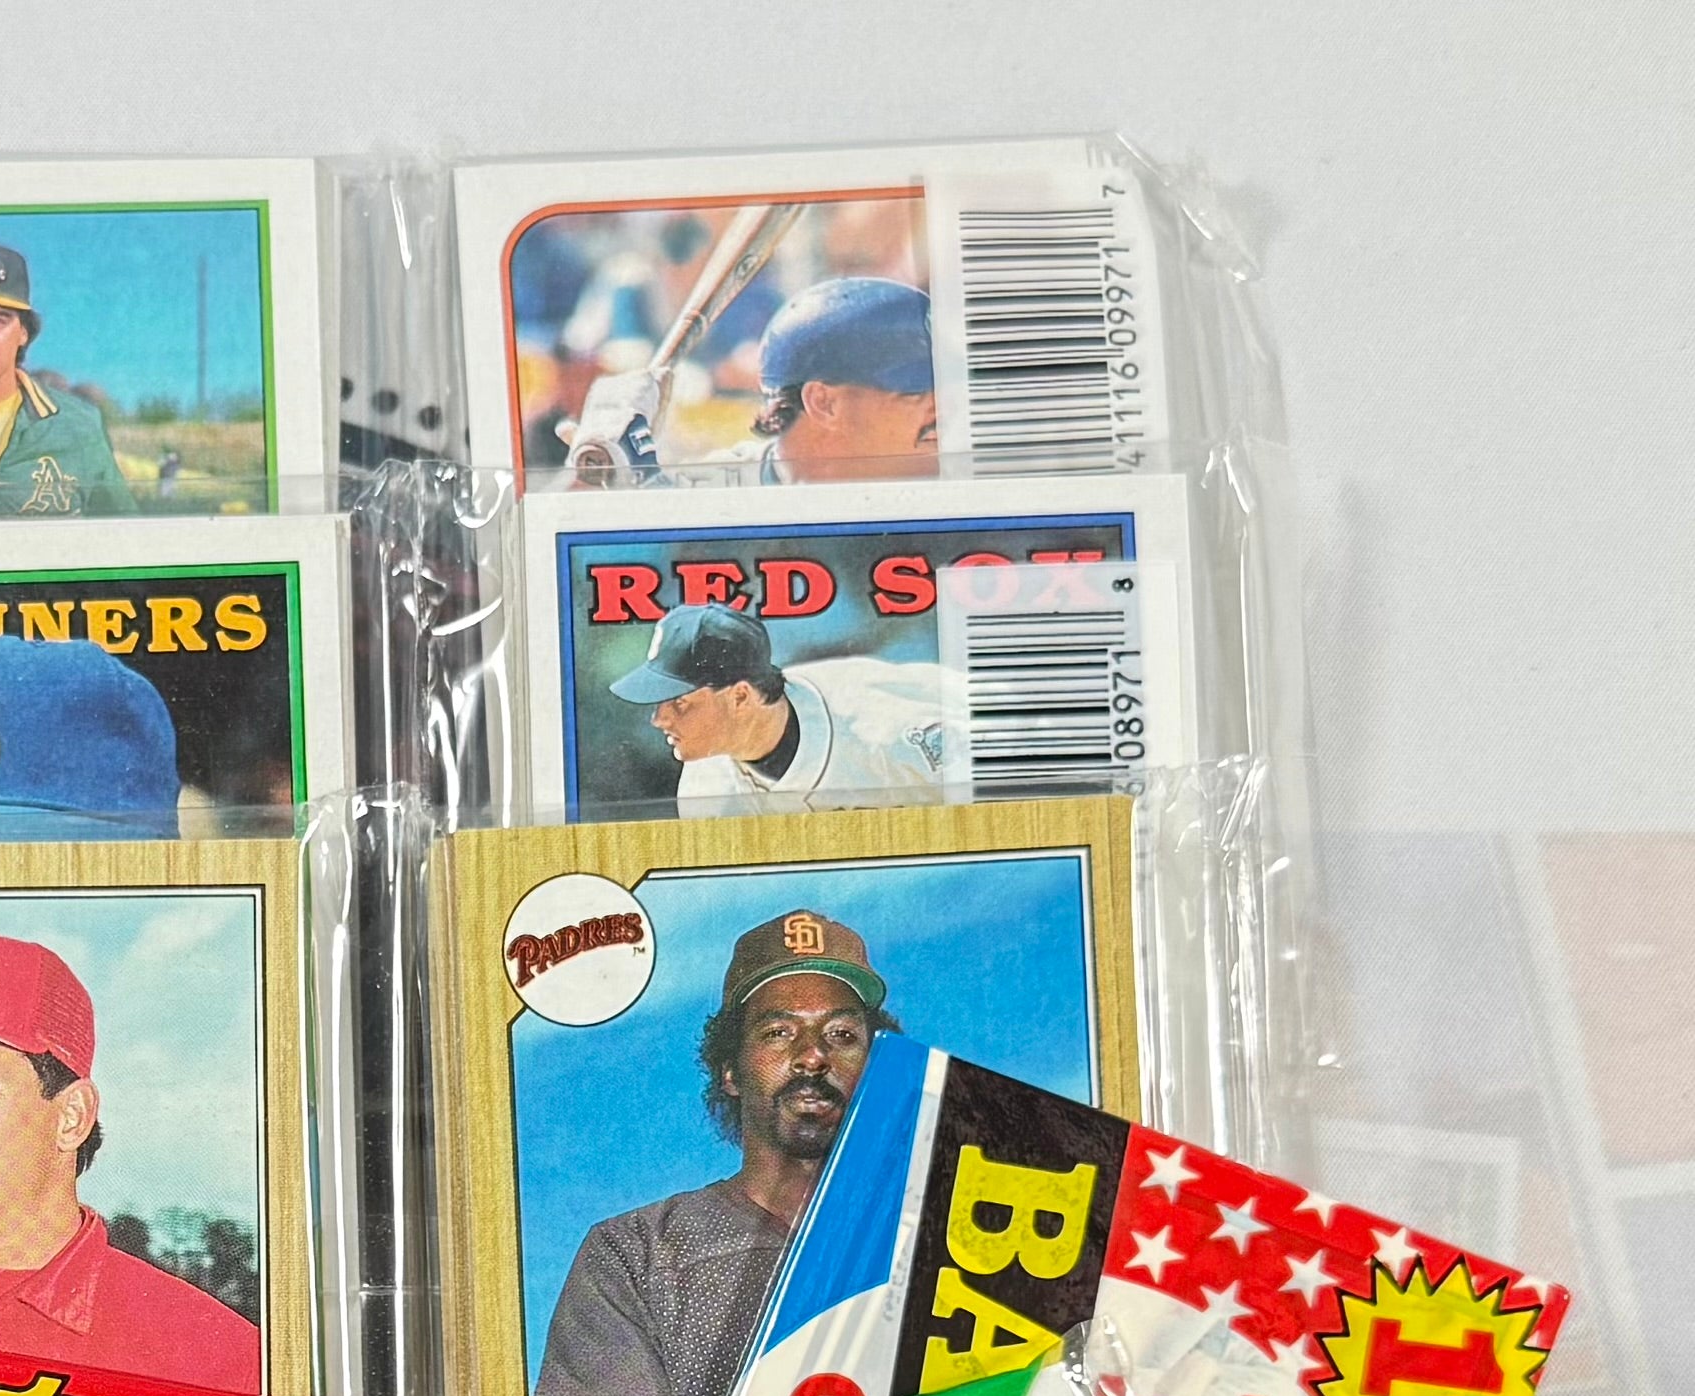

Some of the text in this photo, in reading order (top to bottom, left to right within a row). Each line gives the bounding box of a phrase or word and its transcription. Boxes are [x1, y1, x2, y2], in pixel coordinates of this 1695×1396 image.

[1102, 247, 1137, 348] 09971
[1111, 363, 1147, 468] 41116
[589, 550, 1107, 625] RED SOX
[1112, 648, 1147, 761] 08971
[506, 912, 645, 989] PADRES
